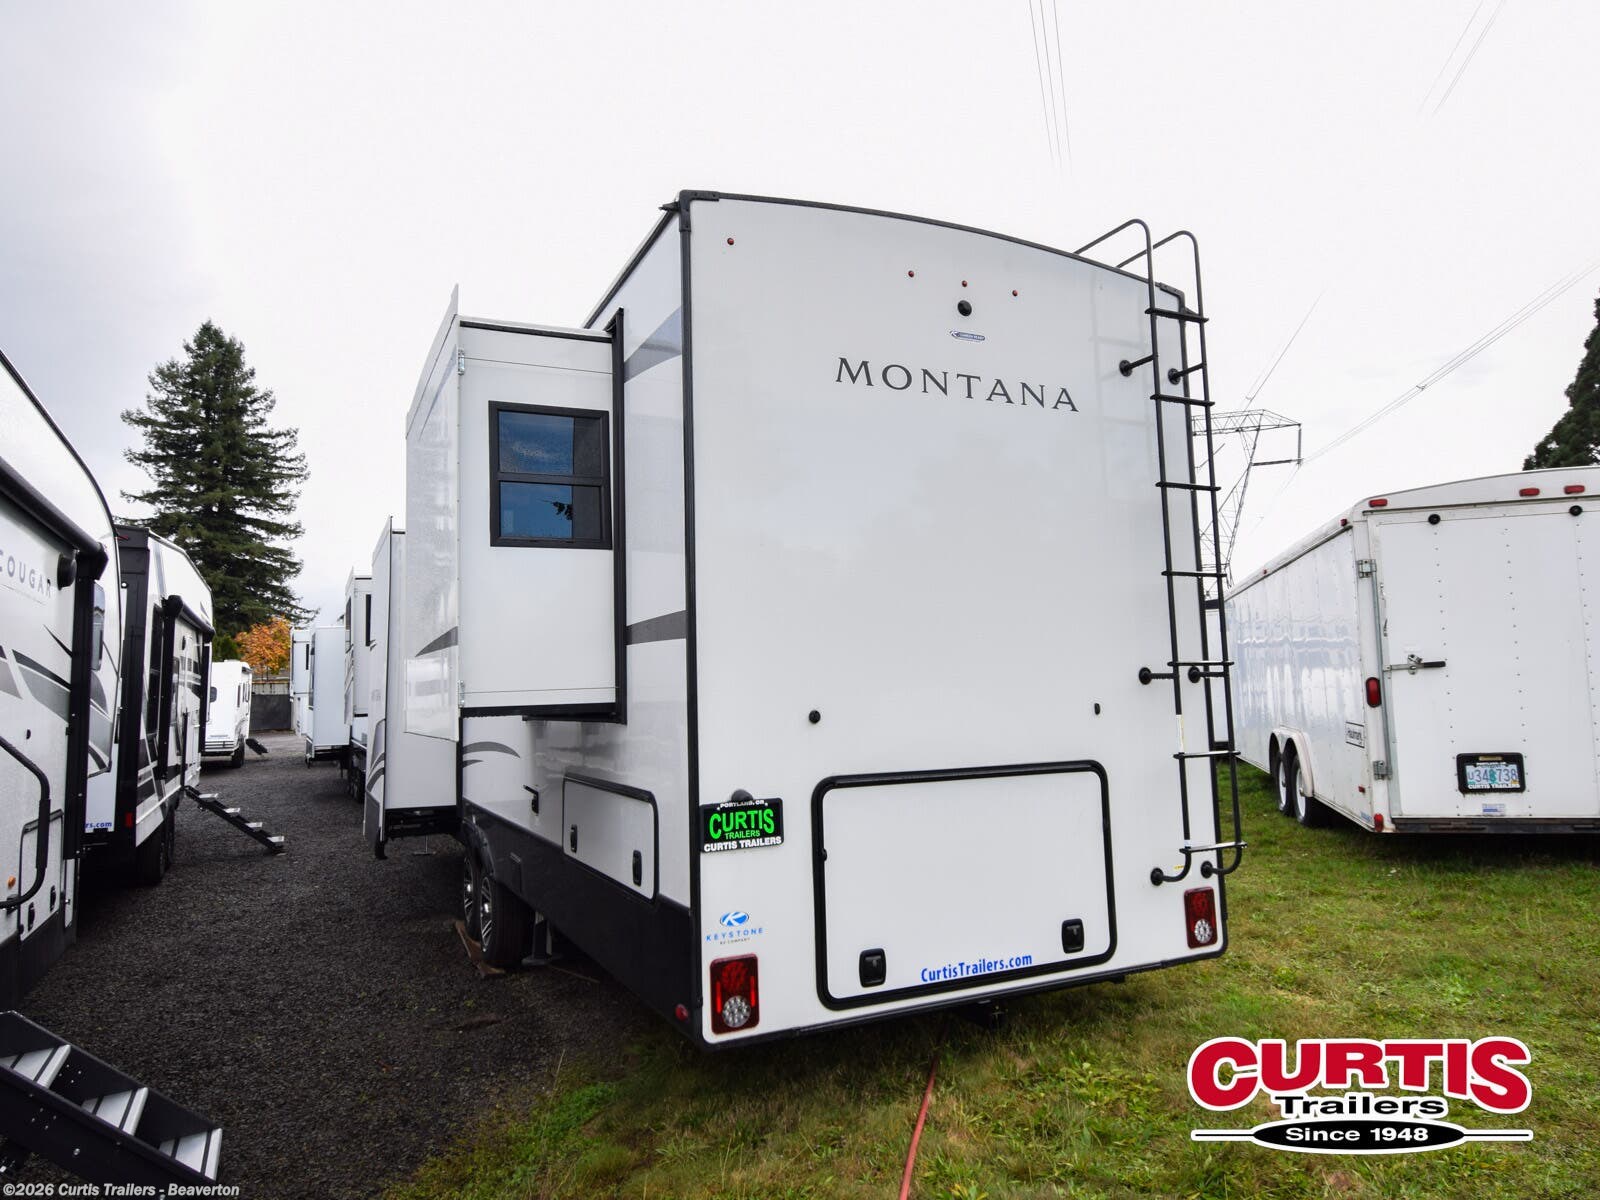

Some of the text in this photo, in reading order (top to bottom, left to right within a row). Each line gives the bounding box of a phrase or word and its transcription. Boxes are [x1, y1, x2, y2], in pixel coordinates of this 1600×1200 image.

[835, 356, 1080, 413] MONTANA
[709, 808, 775, 840] CURTIS
[724, 829, 761, 840] TRAILERS
[703, 836, 782, 852] CURTIS TRAILERS
[705, 927, 764, 942] KEYSTONE
[921, 954, 1033, 982] CurtisTrailers.com
